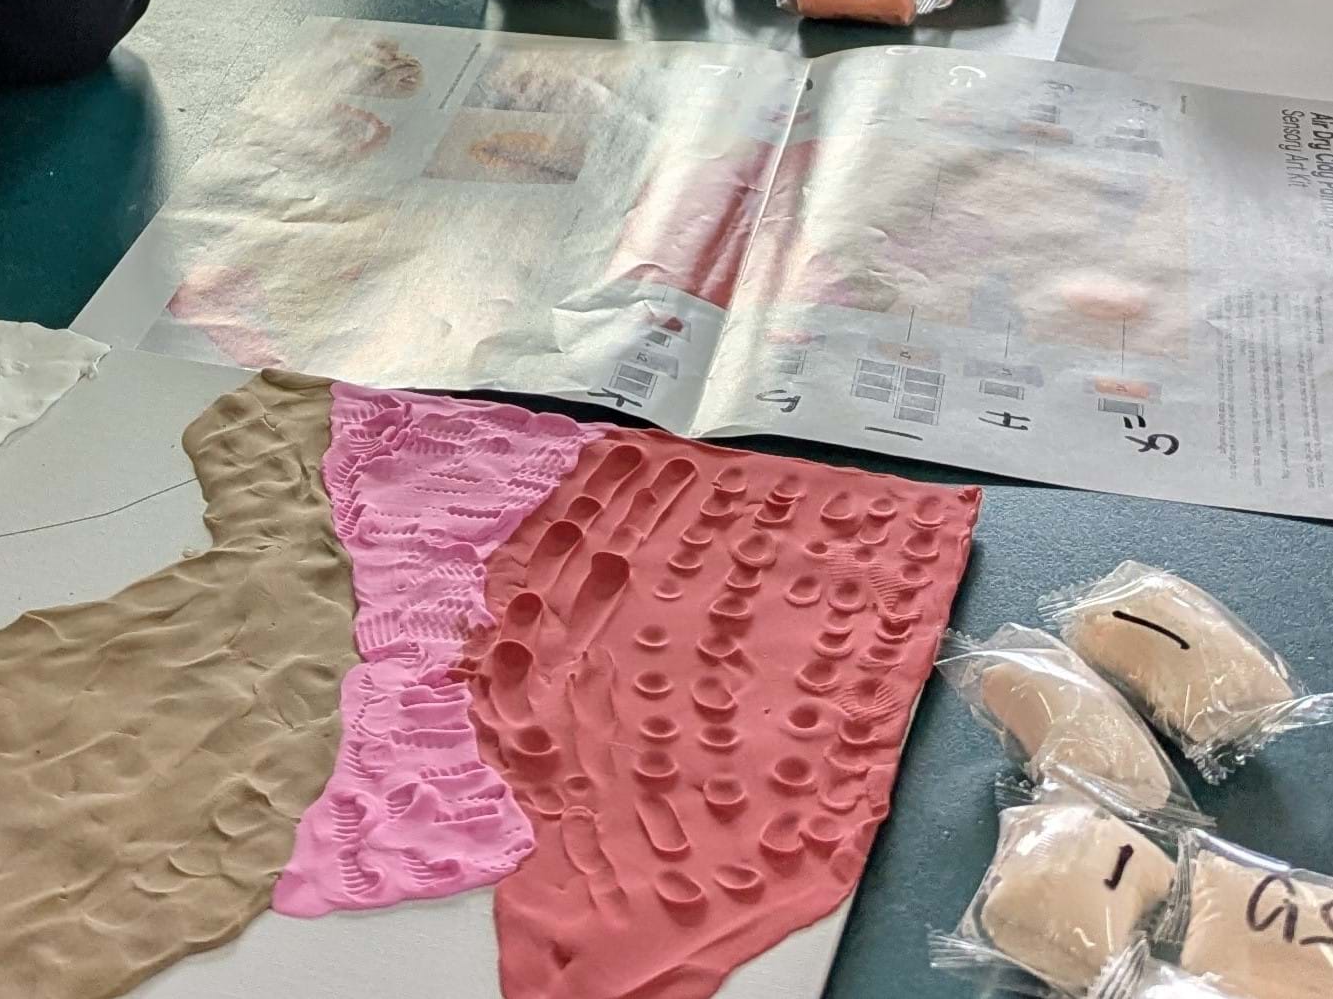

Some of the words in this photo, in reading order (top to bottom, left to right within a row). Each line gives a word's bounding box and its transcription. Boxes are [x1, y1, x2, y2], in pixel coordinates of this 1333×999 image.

[1278, 108, 1305, 151] Sensory
[1308, 130, 1333, 151] Dry
[1285, 152, 1309, 171] Art
[1287, 172, 1312, 188] Kit
